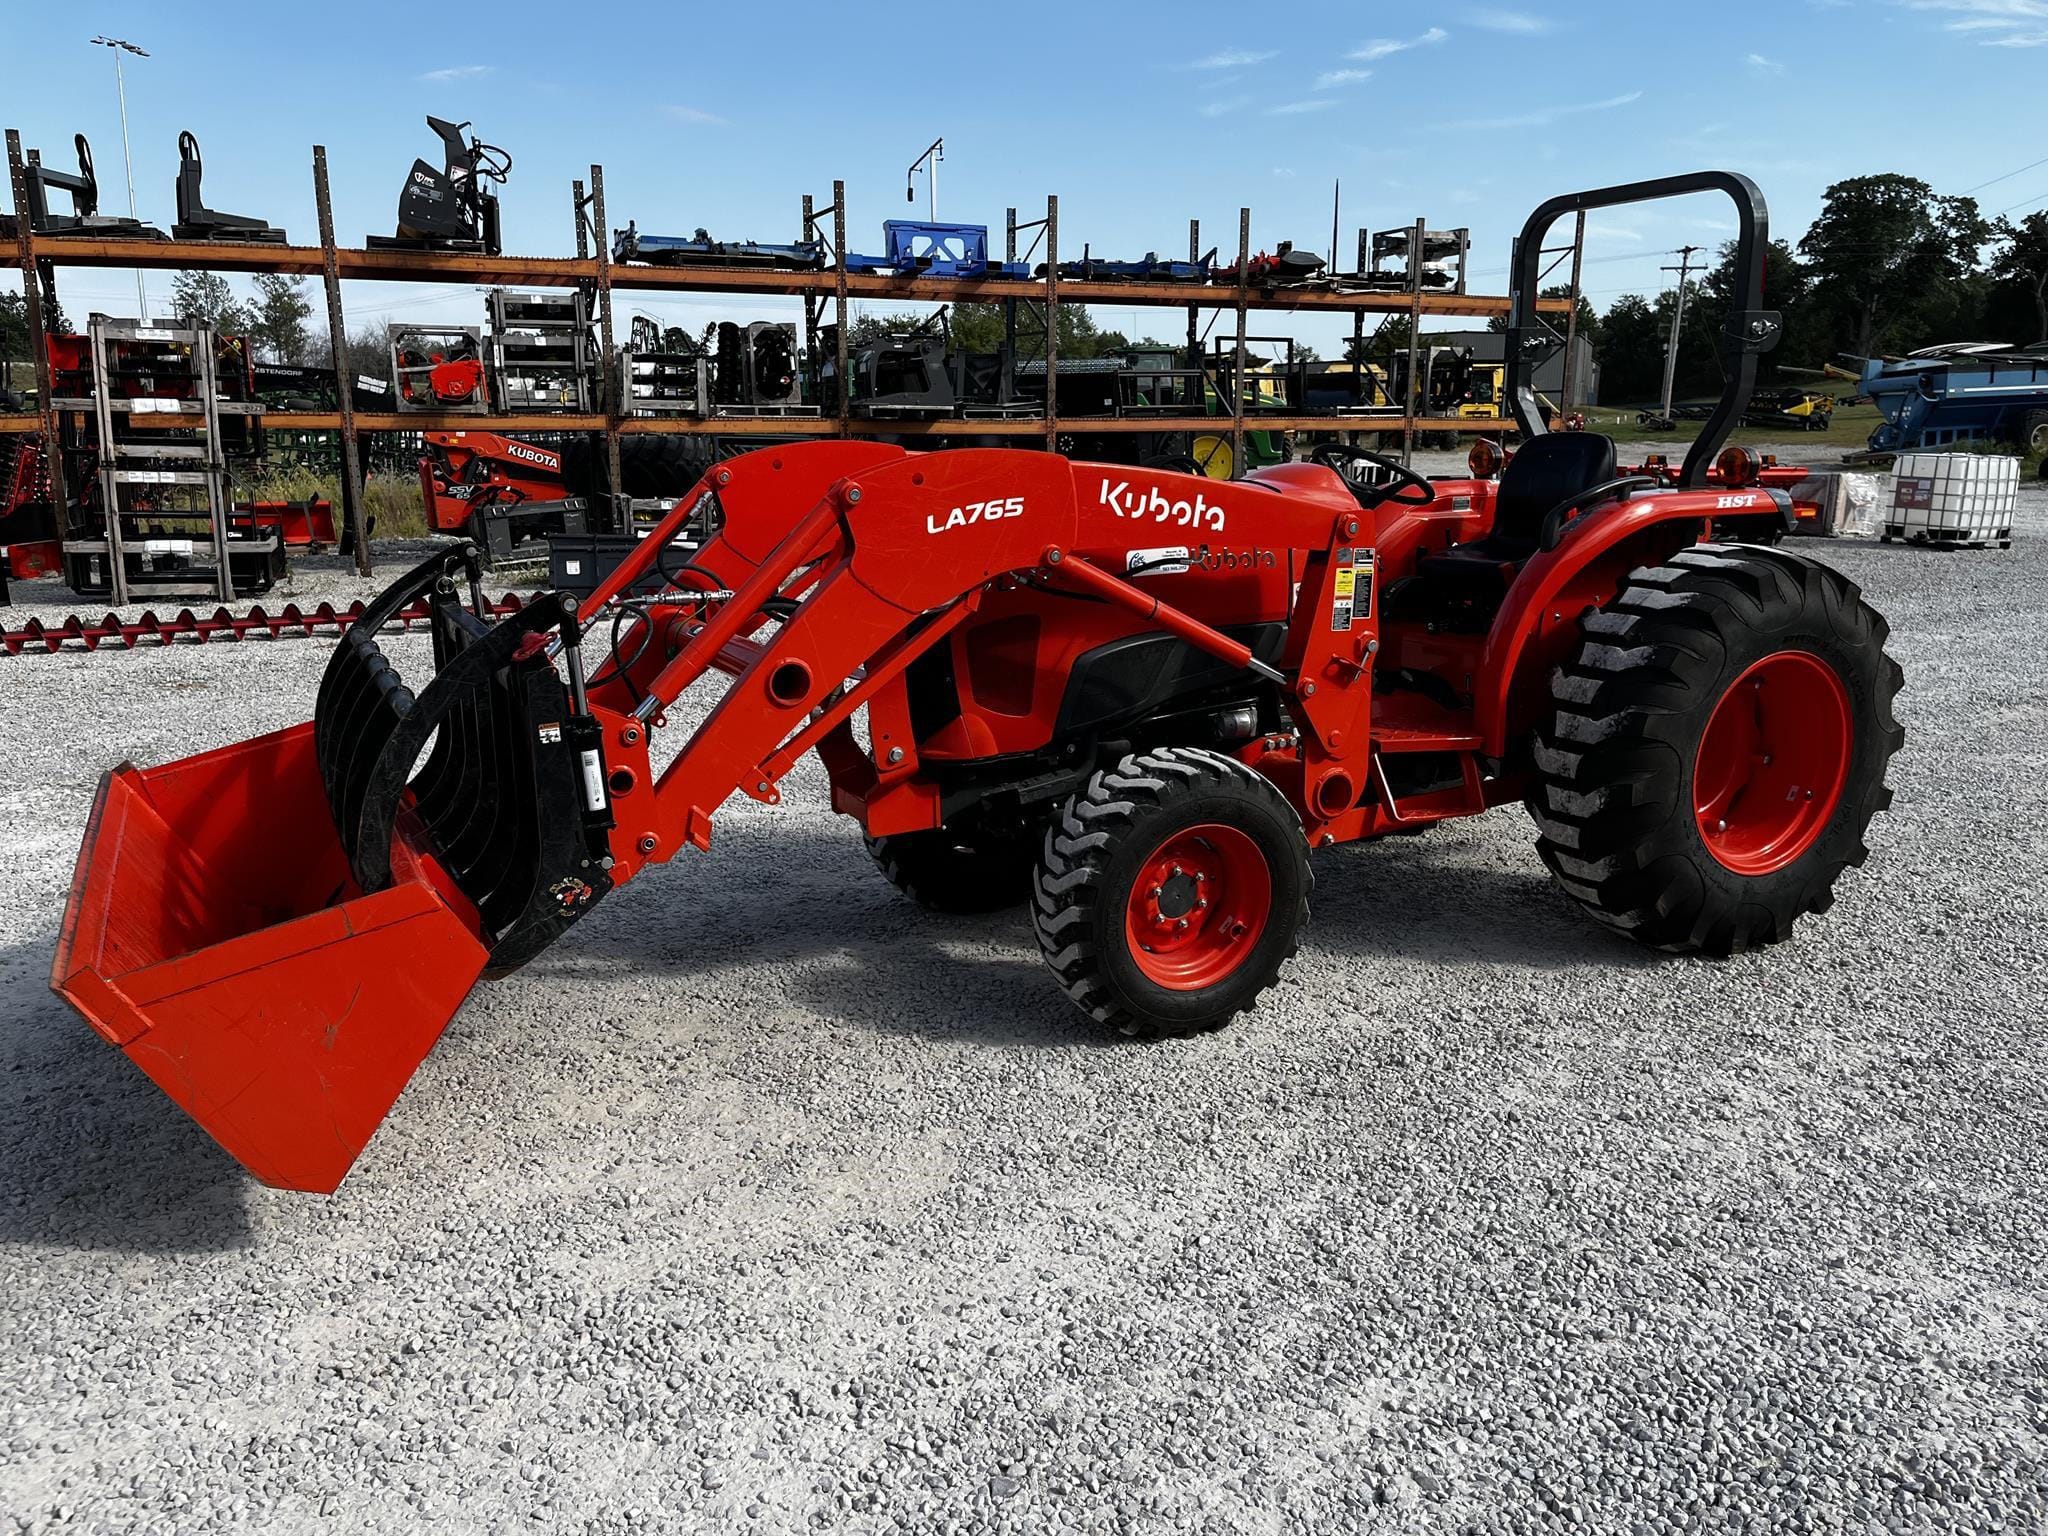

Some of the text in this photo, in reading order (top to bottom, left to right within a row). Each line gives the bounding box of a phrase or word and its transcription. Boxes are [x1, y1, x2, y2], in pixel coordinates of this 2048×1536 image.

[507, 444, 558, 469] KUBOTA
[447, 485, 475, 495] SSV
[1716, 494, 1757, 509] HST
[926, 496, 1025, 534] LA765
[1099, 478, 1226, 532] Kubota
